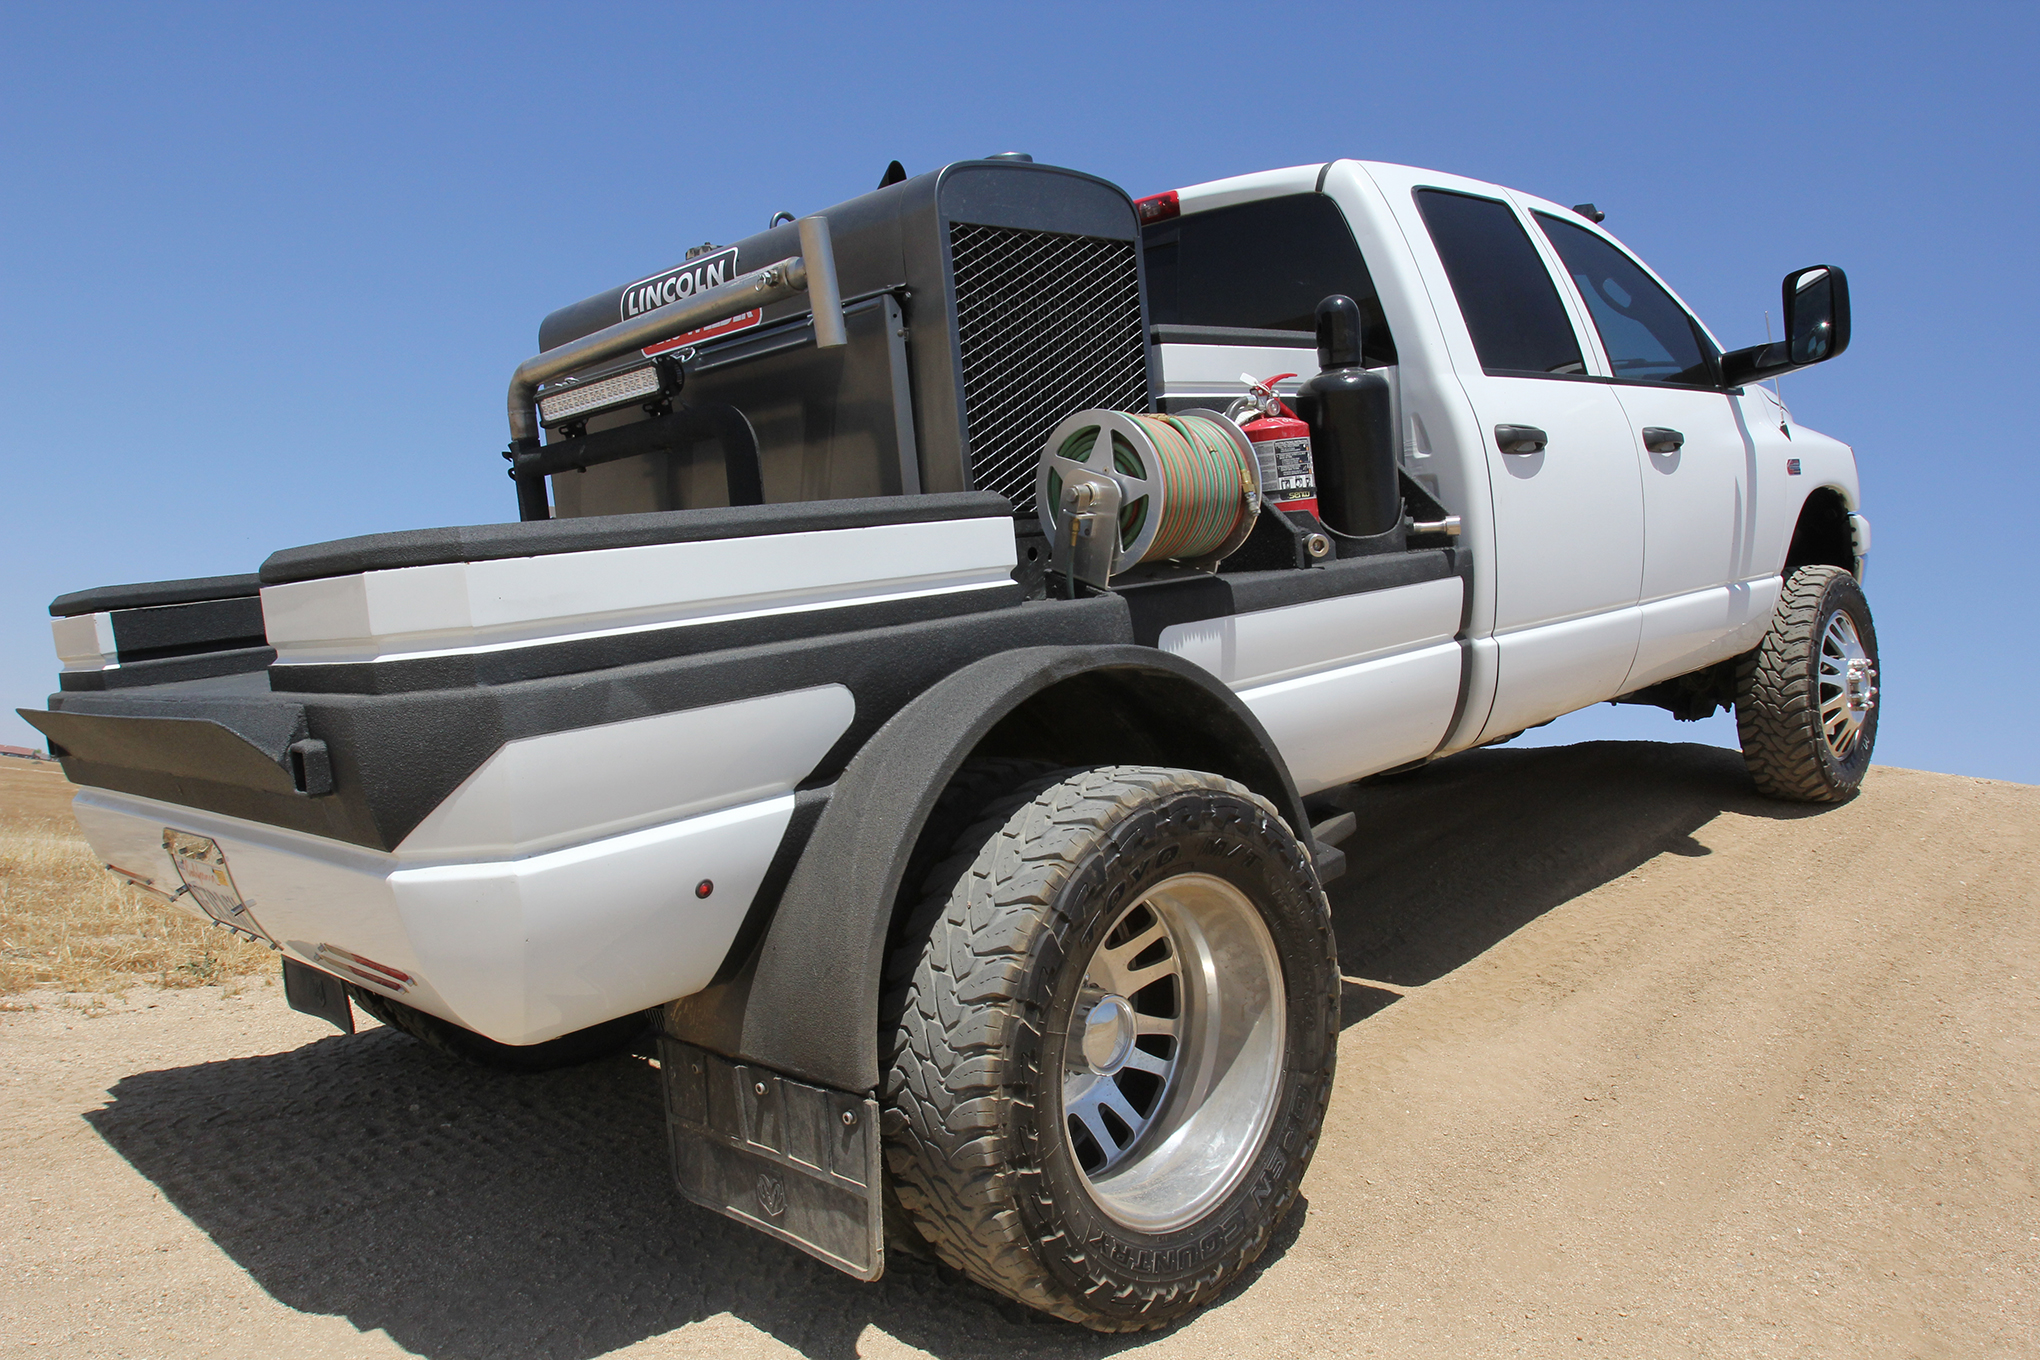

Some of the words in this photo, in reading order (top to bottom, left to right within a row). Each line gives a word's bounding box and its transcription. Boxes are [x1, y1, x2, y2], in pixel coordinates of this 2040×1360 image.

[628, 259, 726, 315] LINCOLN
[1202, 837, 1264, 868] M/T
[1080, 842, 1181, 949] TOYO
[1251, 1085, 1312, 1207] OPEN
[1089, 1208, 1246, 1274] COUNTRY
